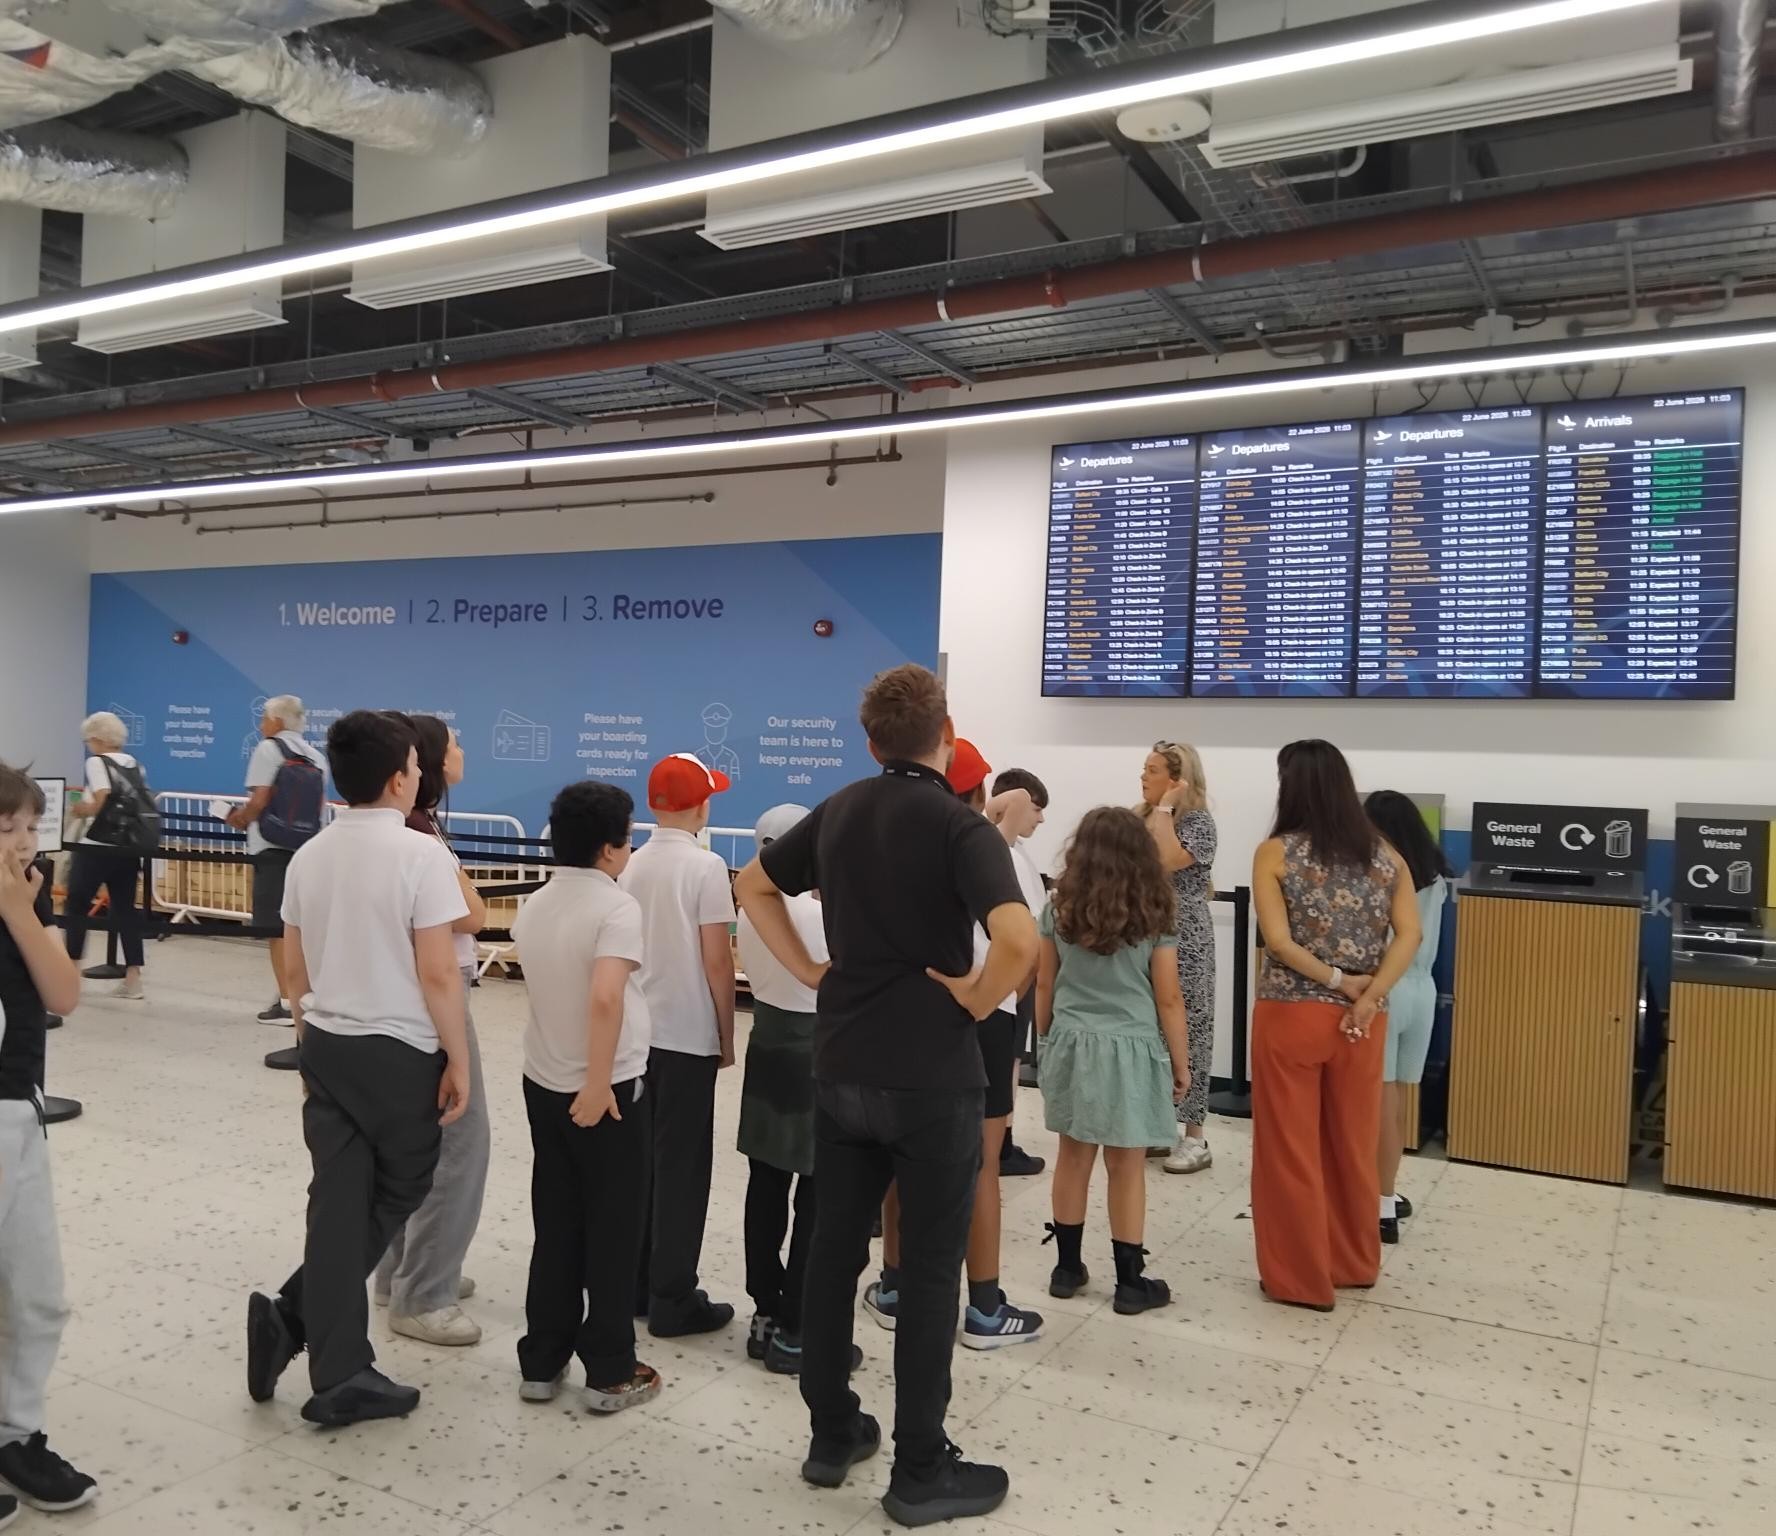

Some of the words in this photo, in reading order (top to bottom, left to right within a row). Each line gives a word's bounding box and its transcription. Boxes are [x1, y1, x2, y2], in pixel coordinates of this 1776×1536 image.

[1665, 397, 1684, 405] June
[1585, 415, 1632, 428] Arrivals
[1298, 427, 1313, 435] June
[1400, 428, 1464, 443] Departures
[1232, 442, 1289, 456] Departures
[1081, 456, 1133, 468] Departures
[279, 603, 291, 626] 1.
[297, 602, 396, 626] Welcome
[426, 599, 446, 624] 2.
[453, 598, 548, 629] Prepare
[582, 595, 604, 621] 3.
[612, 594, 724, 620] Remove
[584, 712, 616, 724] Please
[618, 713, 643, 724] have
[767, 716, 788, 728] Our
[791, 716, 837, 730] security
[578, 732, 600, 742] your
[603, 730, 647, 745] boarding
[759, 736, 788, 747] team
[790, 735, 800, 747] is
[803, 735, 828, 747] here
[832, 737, 843, 748] to
[576, 748, 602, 760] cards
[604, 749, 632, 762] ready
[634, 749, 648, 760] for
[759, 754, 786, 768] keep
[789, 756, 842, 769] everyone
[586, 766, 637, 777] inspection
[787, 773, 811, 785] safe
[1486, 820, 1542, 834] General
[1699, 825, 1747, 836] General
[1491, 835, 1536, 848] Waste
[1703, 839, 1743, 850] Waste
